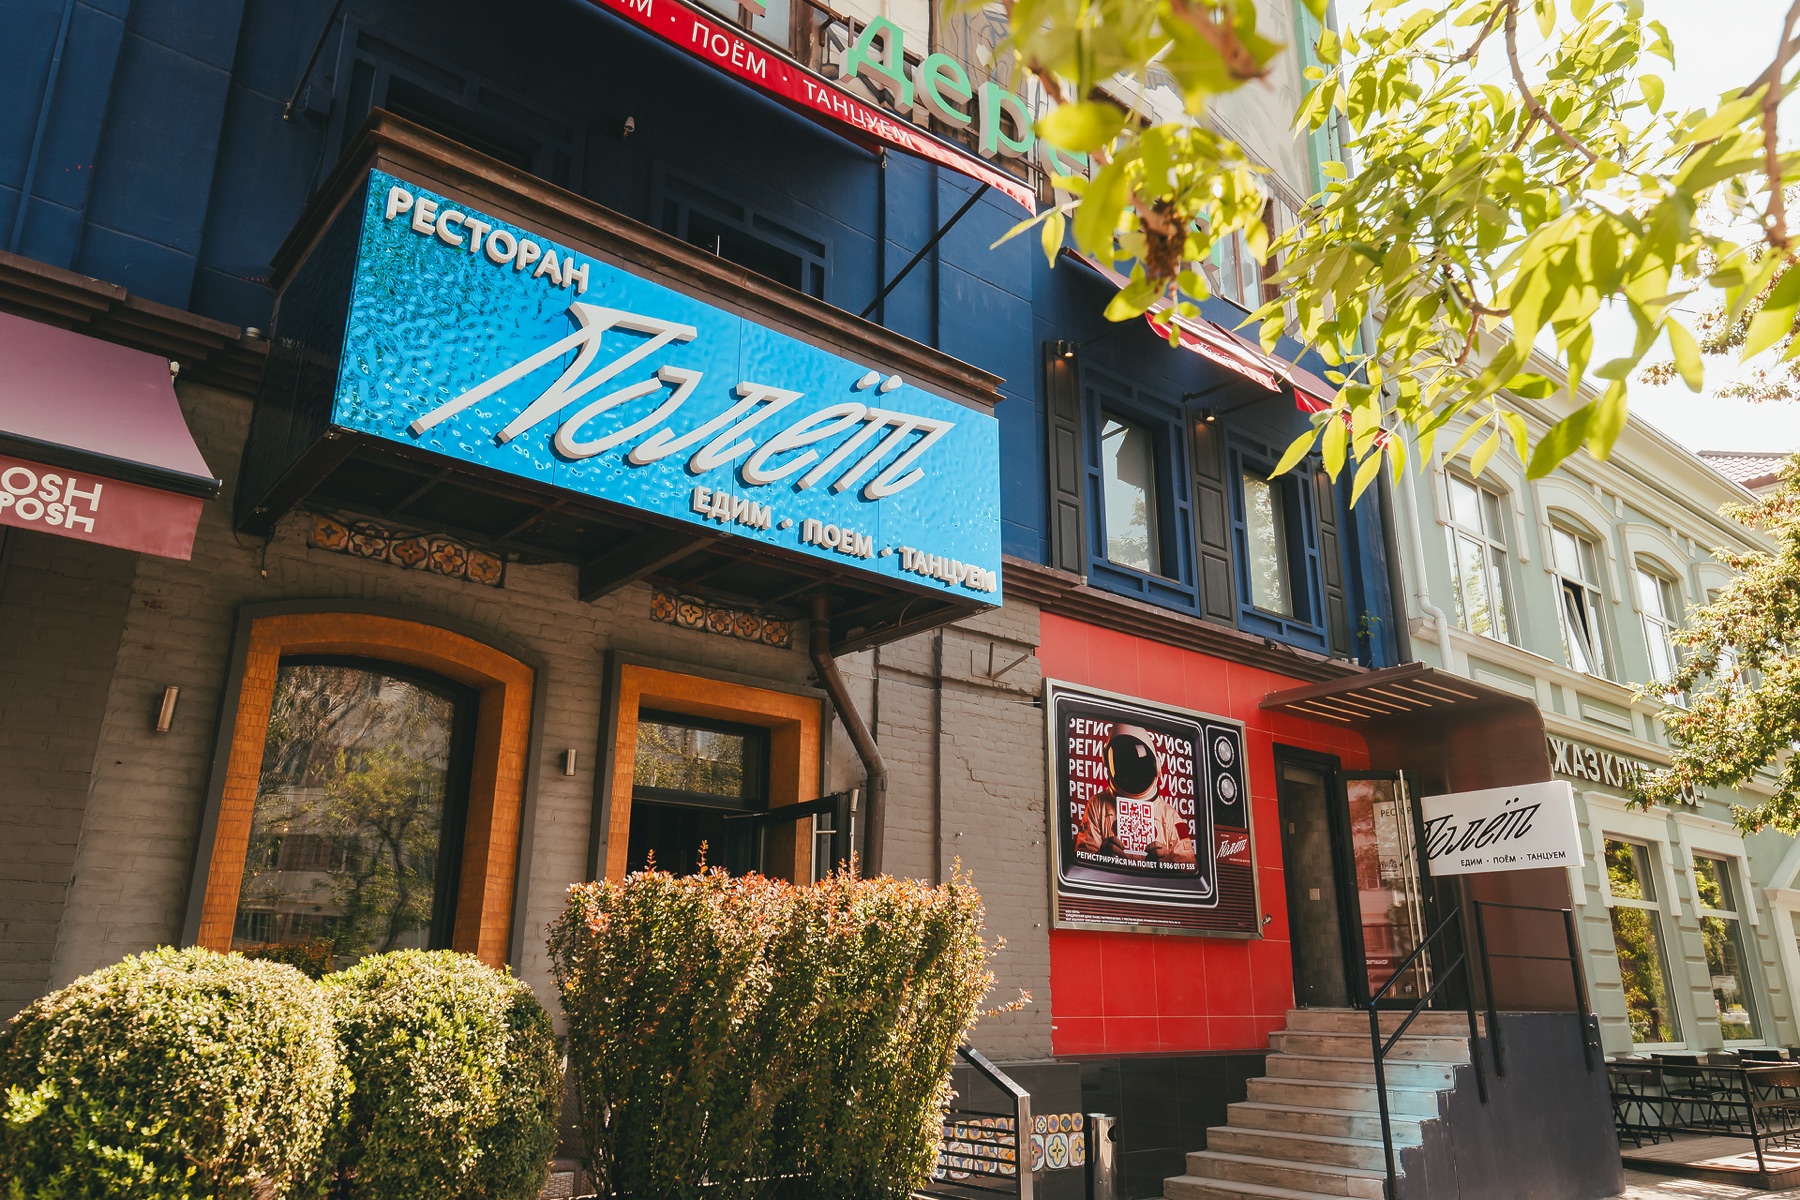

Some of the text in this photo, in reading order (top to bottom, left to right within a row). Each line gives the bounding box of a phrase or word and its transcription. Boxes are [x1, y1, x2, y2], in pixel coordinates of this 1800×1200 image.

[691, 21, 914, 147] ПОЁМ ТАНЦУЕМ
[386, 186, 590, 294] РЕСТОРАН
[410, 302, 956, 500] Полёт
[0, 491, 95, 533] POSH
[692, 486, 997, 593] ЕДИМ ПОЕМ ТАНЦУЕМ
[1548, 737, 1601, 782] ЖАЗ
[1076, 850, 1128, 866] РЕГИСТРИРУЙСЯ
[1127, 859, 1137, 867] НА
[1401, 797, 1542, 866] Полёт
[1461, 850, 1567, 867] ЕДИМ ПОЁМ ТАНЦУЕМ
